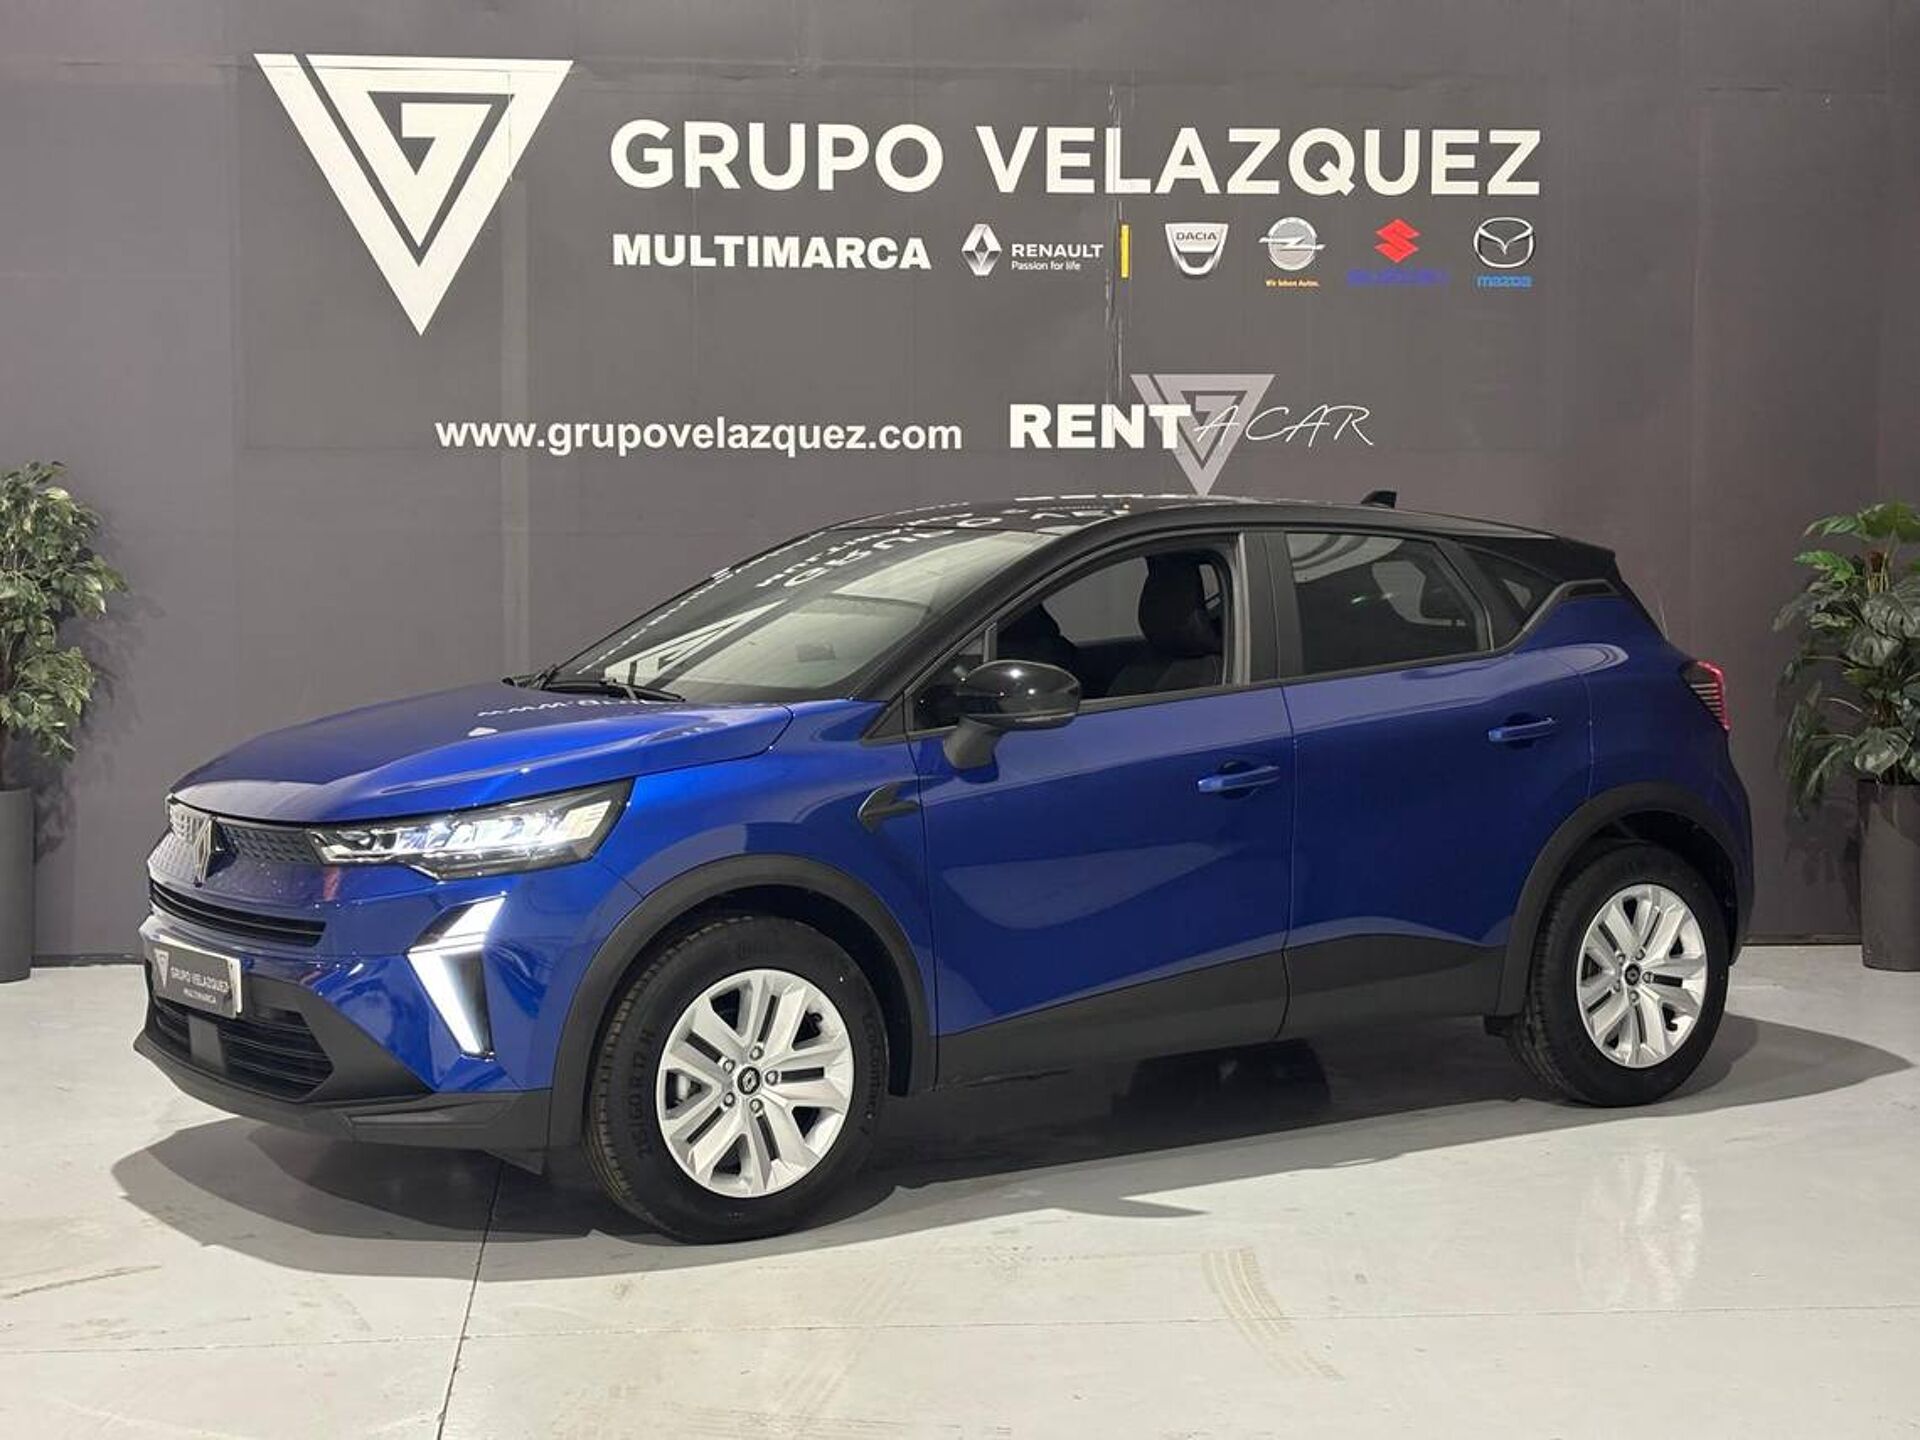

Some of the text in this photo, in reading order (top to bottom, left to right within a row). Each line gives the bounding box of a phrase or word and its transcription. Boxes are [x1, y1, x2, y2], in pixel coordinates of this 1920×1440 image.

[609, 119, 1541, 197] GRUPO VELAZQUEZ
[612, 233, 933, 271] MULTIMARCA
[1011, 243, 1104, 259] RENAULT
[1175, 231, 1217, 242] DACIA
[1011, 260, 1082, 272] Passion for life
[435, 415, 963, 458] www.grupovelazquez.com
[1009, 404, 1192, 449] RENT
